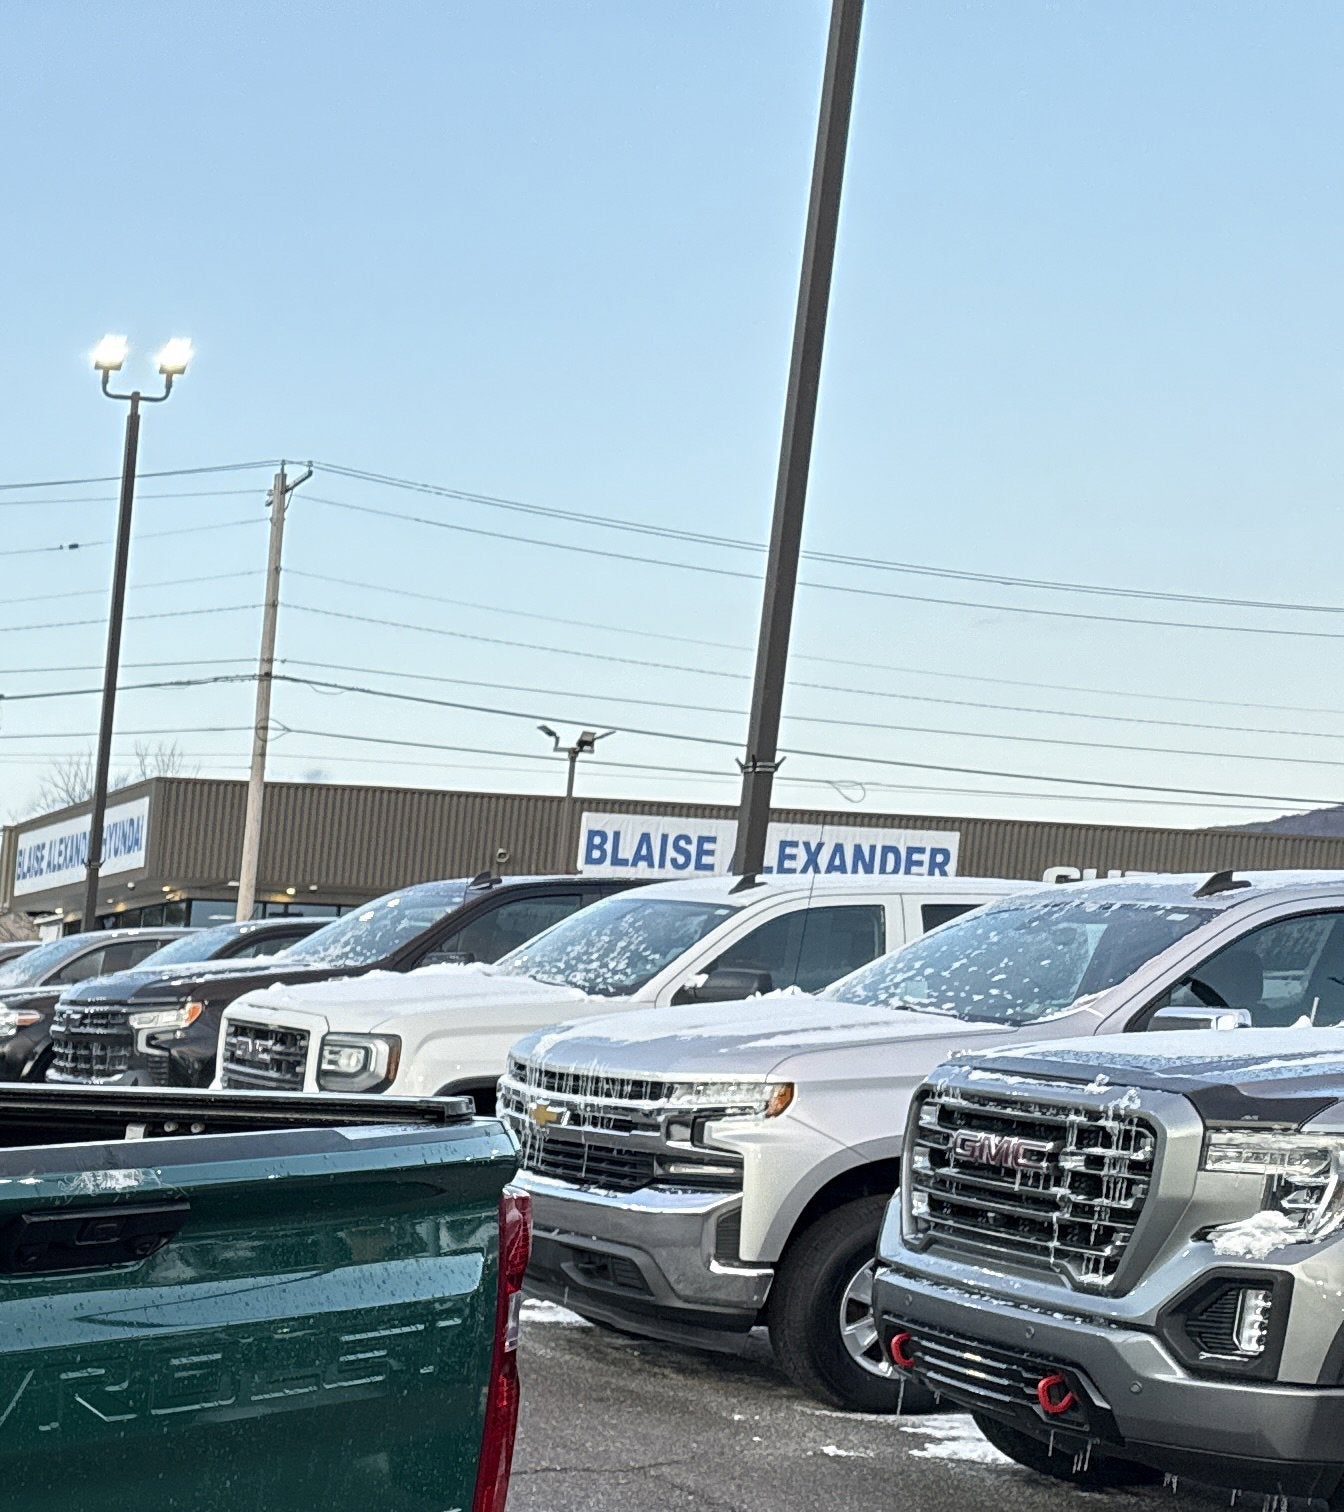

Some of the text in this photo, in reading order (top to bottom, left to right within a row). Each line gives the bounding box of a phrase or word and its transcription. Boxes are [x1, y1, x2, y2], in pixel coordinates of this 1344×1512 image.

[16, 842, 51, 881] BLAISE
[45, 831, 91, 874] ALEXAND
[584, 829, 717, 871] BLAISE
[954, 1129, 1053, 1173] GMC
